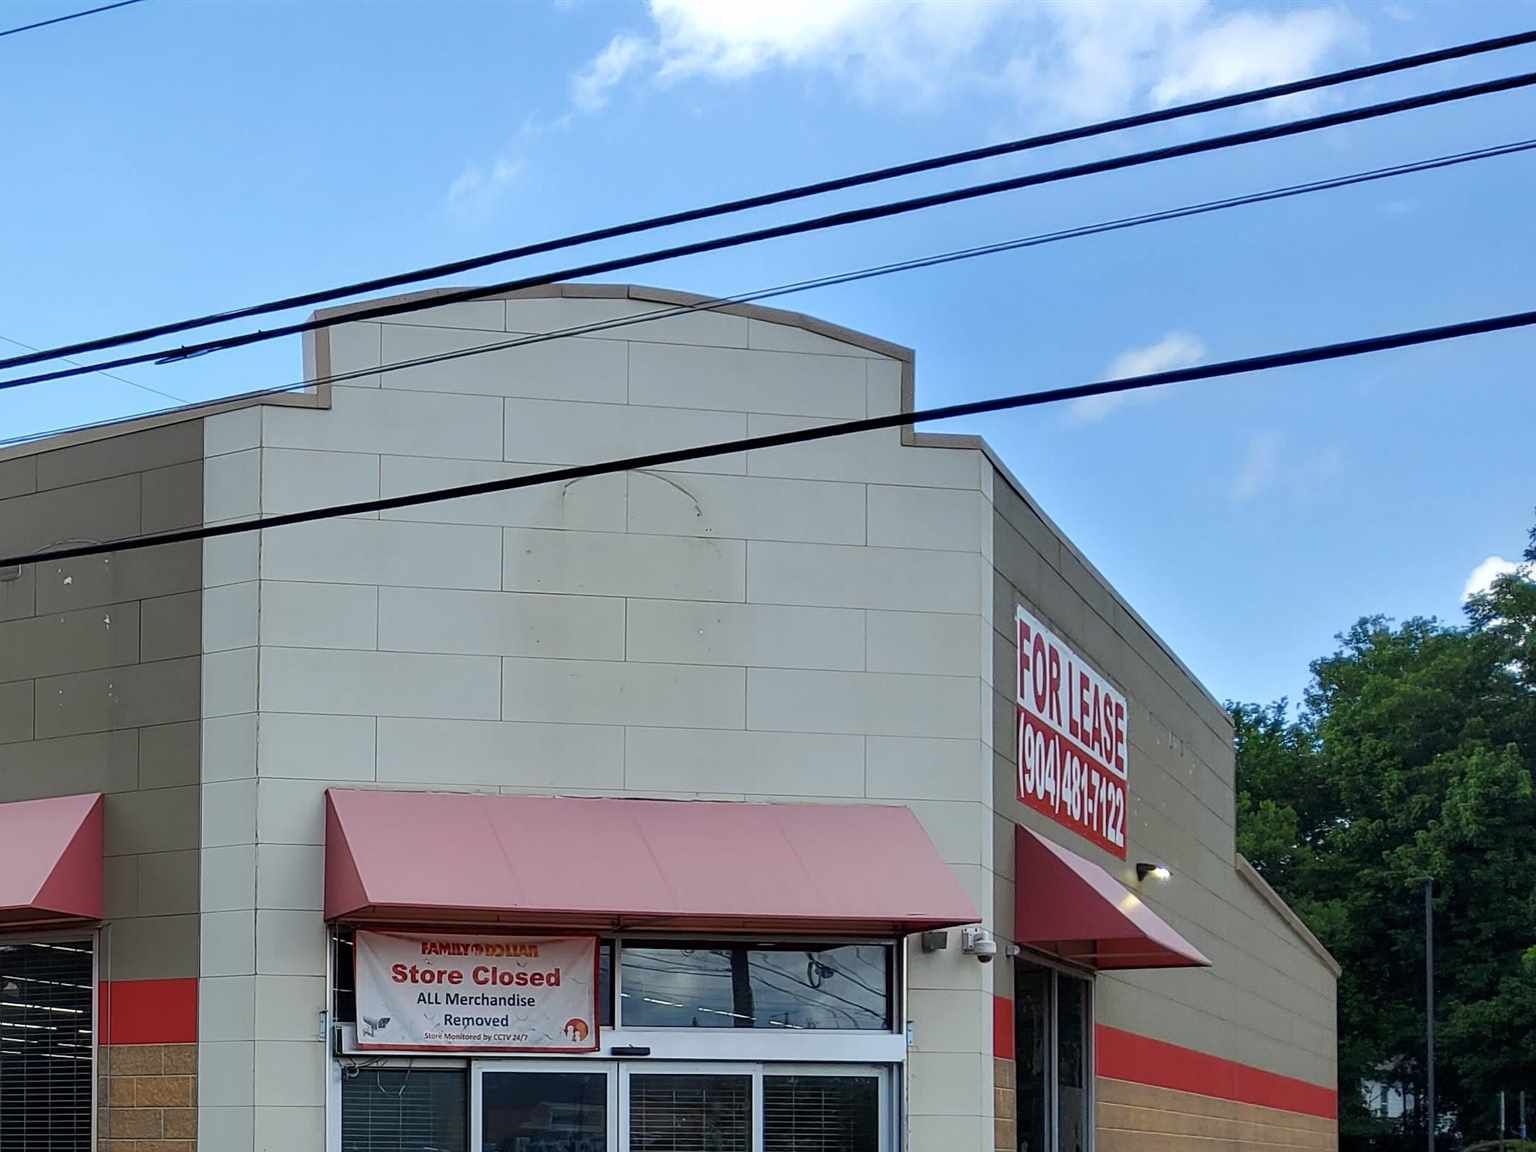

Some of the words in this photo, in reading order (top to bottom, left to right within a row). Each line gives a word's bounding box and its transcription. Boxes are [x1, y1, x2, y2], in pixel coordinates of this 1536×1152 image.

[1019, 618, 1062, 726] FOR
[1068, 660, 1125, 773] LEASE
[421, 942, 471, 956] FAMILY
[392, 963, 463, 985] Store
[472, 965, 561, 987] Closed
[417, 992, 442, 1005] ALL
[445, 993, 536, 1007] Merchandise
[444, 1014, 509, 1027] Removed
[424, 1032, 443, 1040] Store
[444, 1033, 482, 1041] Monitored
[483, 1033, 492, 1042] by
